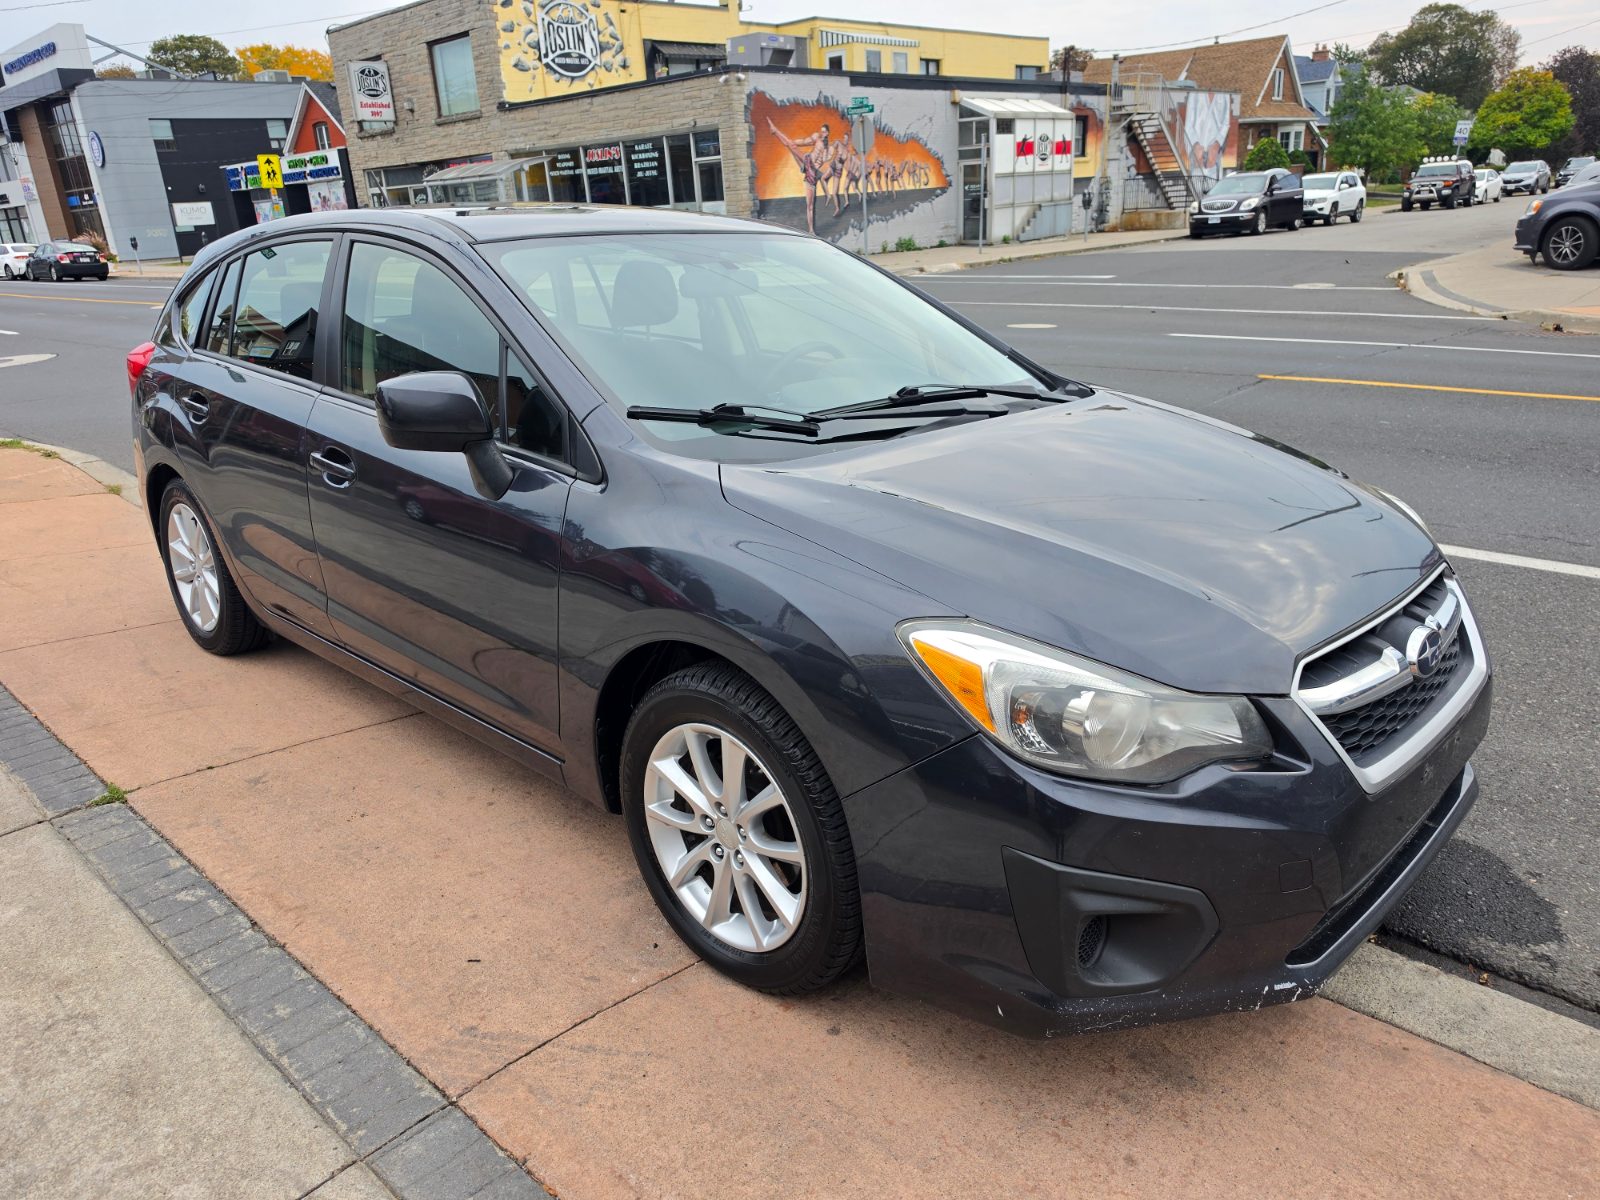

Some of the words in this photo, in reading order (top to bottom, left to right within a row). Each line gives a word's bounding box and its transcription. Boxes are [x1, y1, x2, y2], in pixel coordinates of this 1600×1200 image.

[541, 17, 598, 59] JOSLIN'S
[357, 72, 387, 92] JOSLIN'S
[360, 101, 391, 109] Established
[1456, 127, 1468, 135] 40
[634, 143, 653, 151] KARATE
[586, 146, 621, 162] JOSLIN'S
[634, 161, 658, 169] BRAZILIAN
